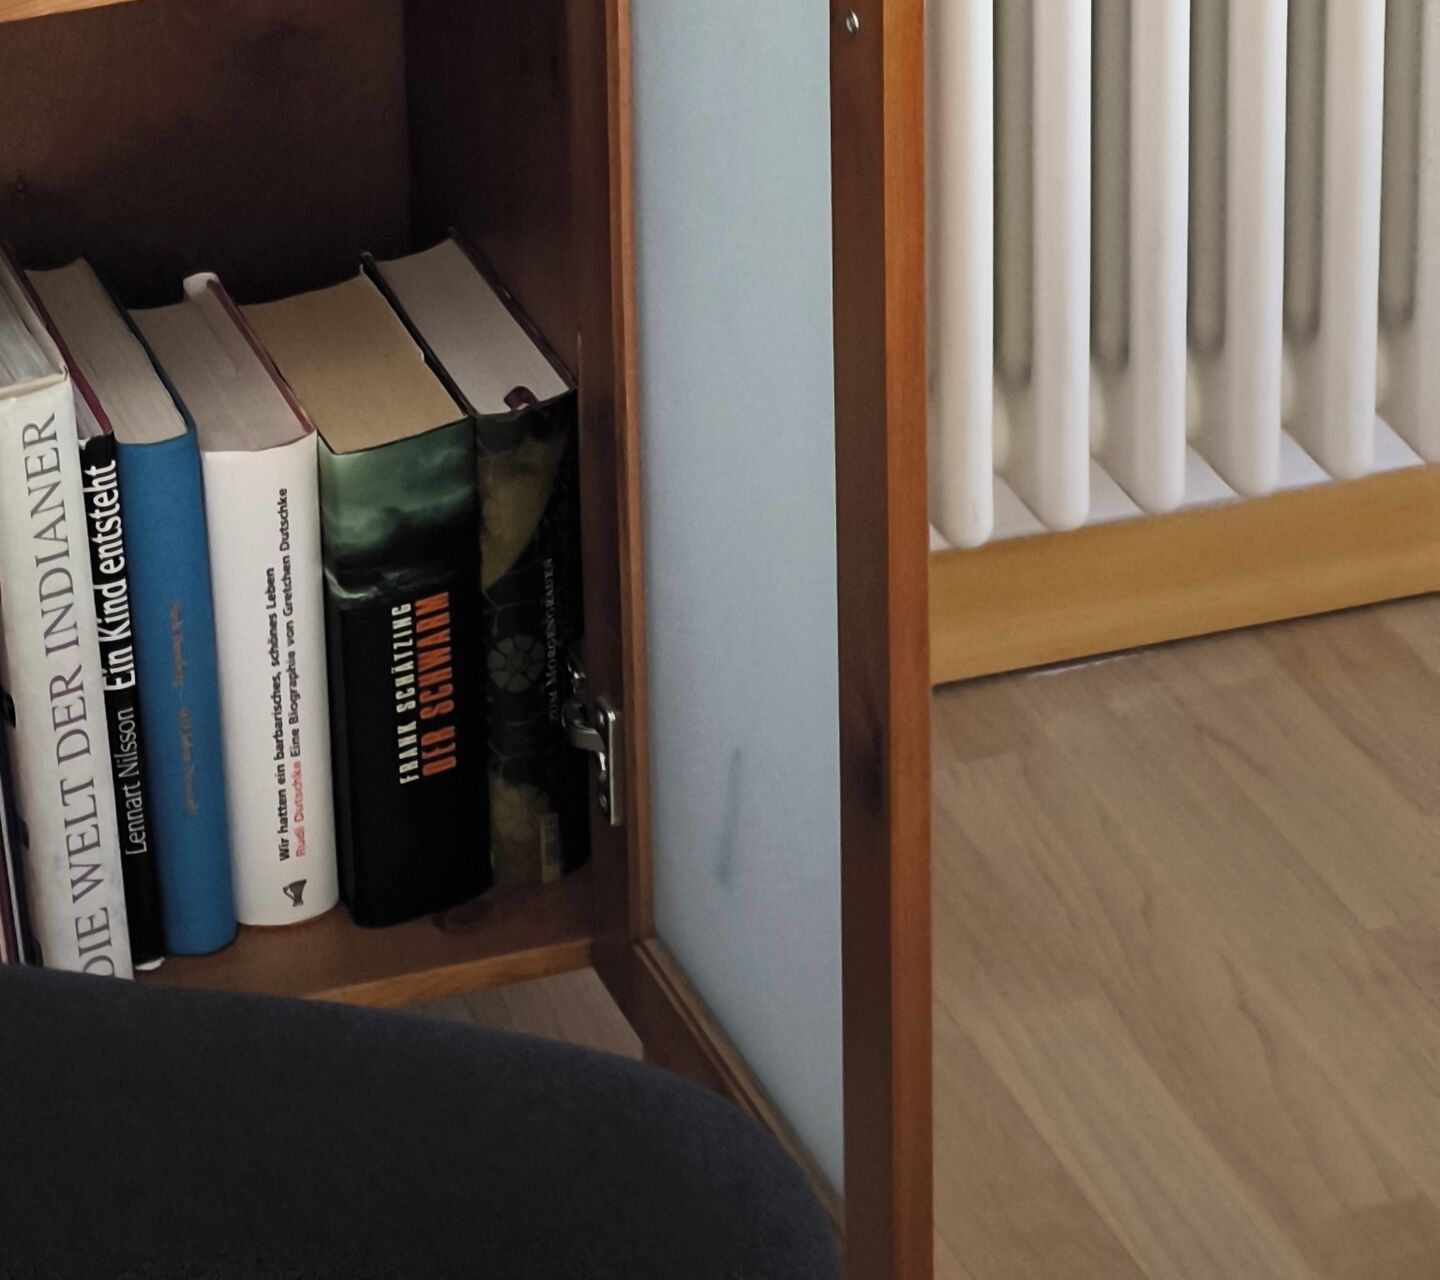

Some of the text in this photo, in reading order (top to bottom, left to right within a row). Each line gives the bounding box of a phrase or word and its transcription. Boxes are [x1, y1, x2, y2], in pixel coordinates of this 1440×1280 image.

[21, 412, 116, 977] DIE WELT DER INDIANER
[82, 460, 147, 856] Lennart Nilsson Ein Kind entsteht
[265, 567, 291, 862] Wir hatten ein schönes Leben
[277, 488, 306, 857] Rudi Dutschke Eine Biographie von Gretchen Dutschke
[391, 603, 420, 784] FRANK SCHÄTZING
[414, 591, 457, 776] DER SCHWARM
[543, 558, 558, 687] MORGENGRAUEN
